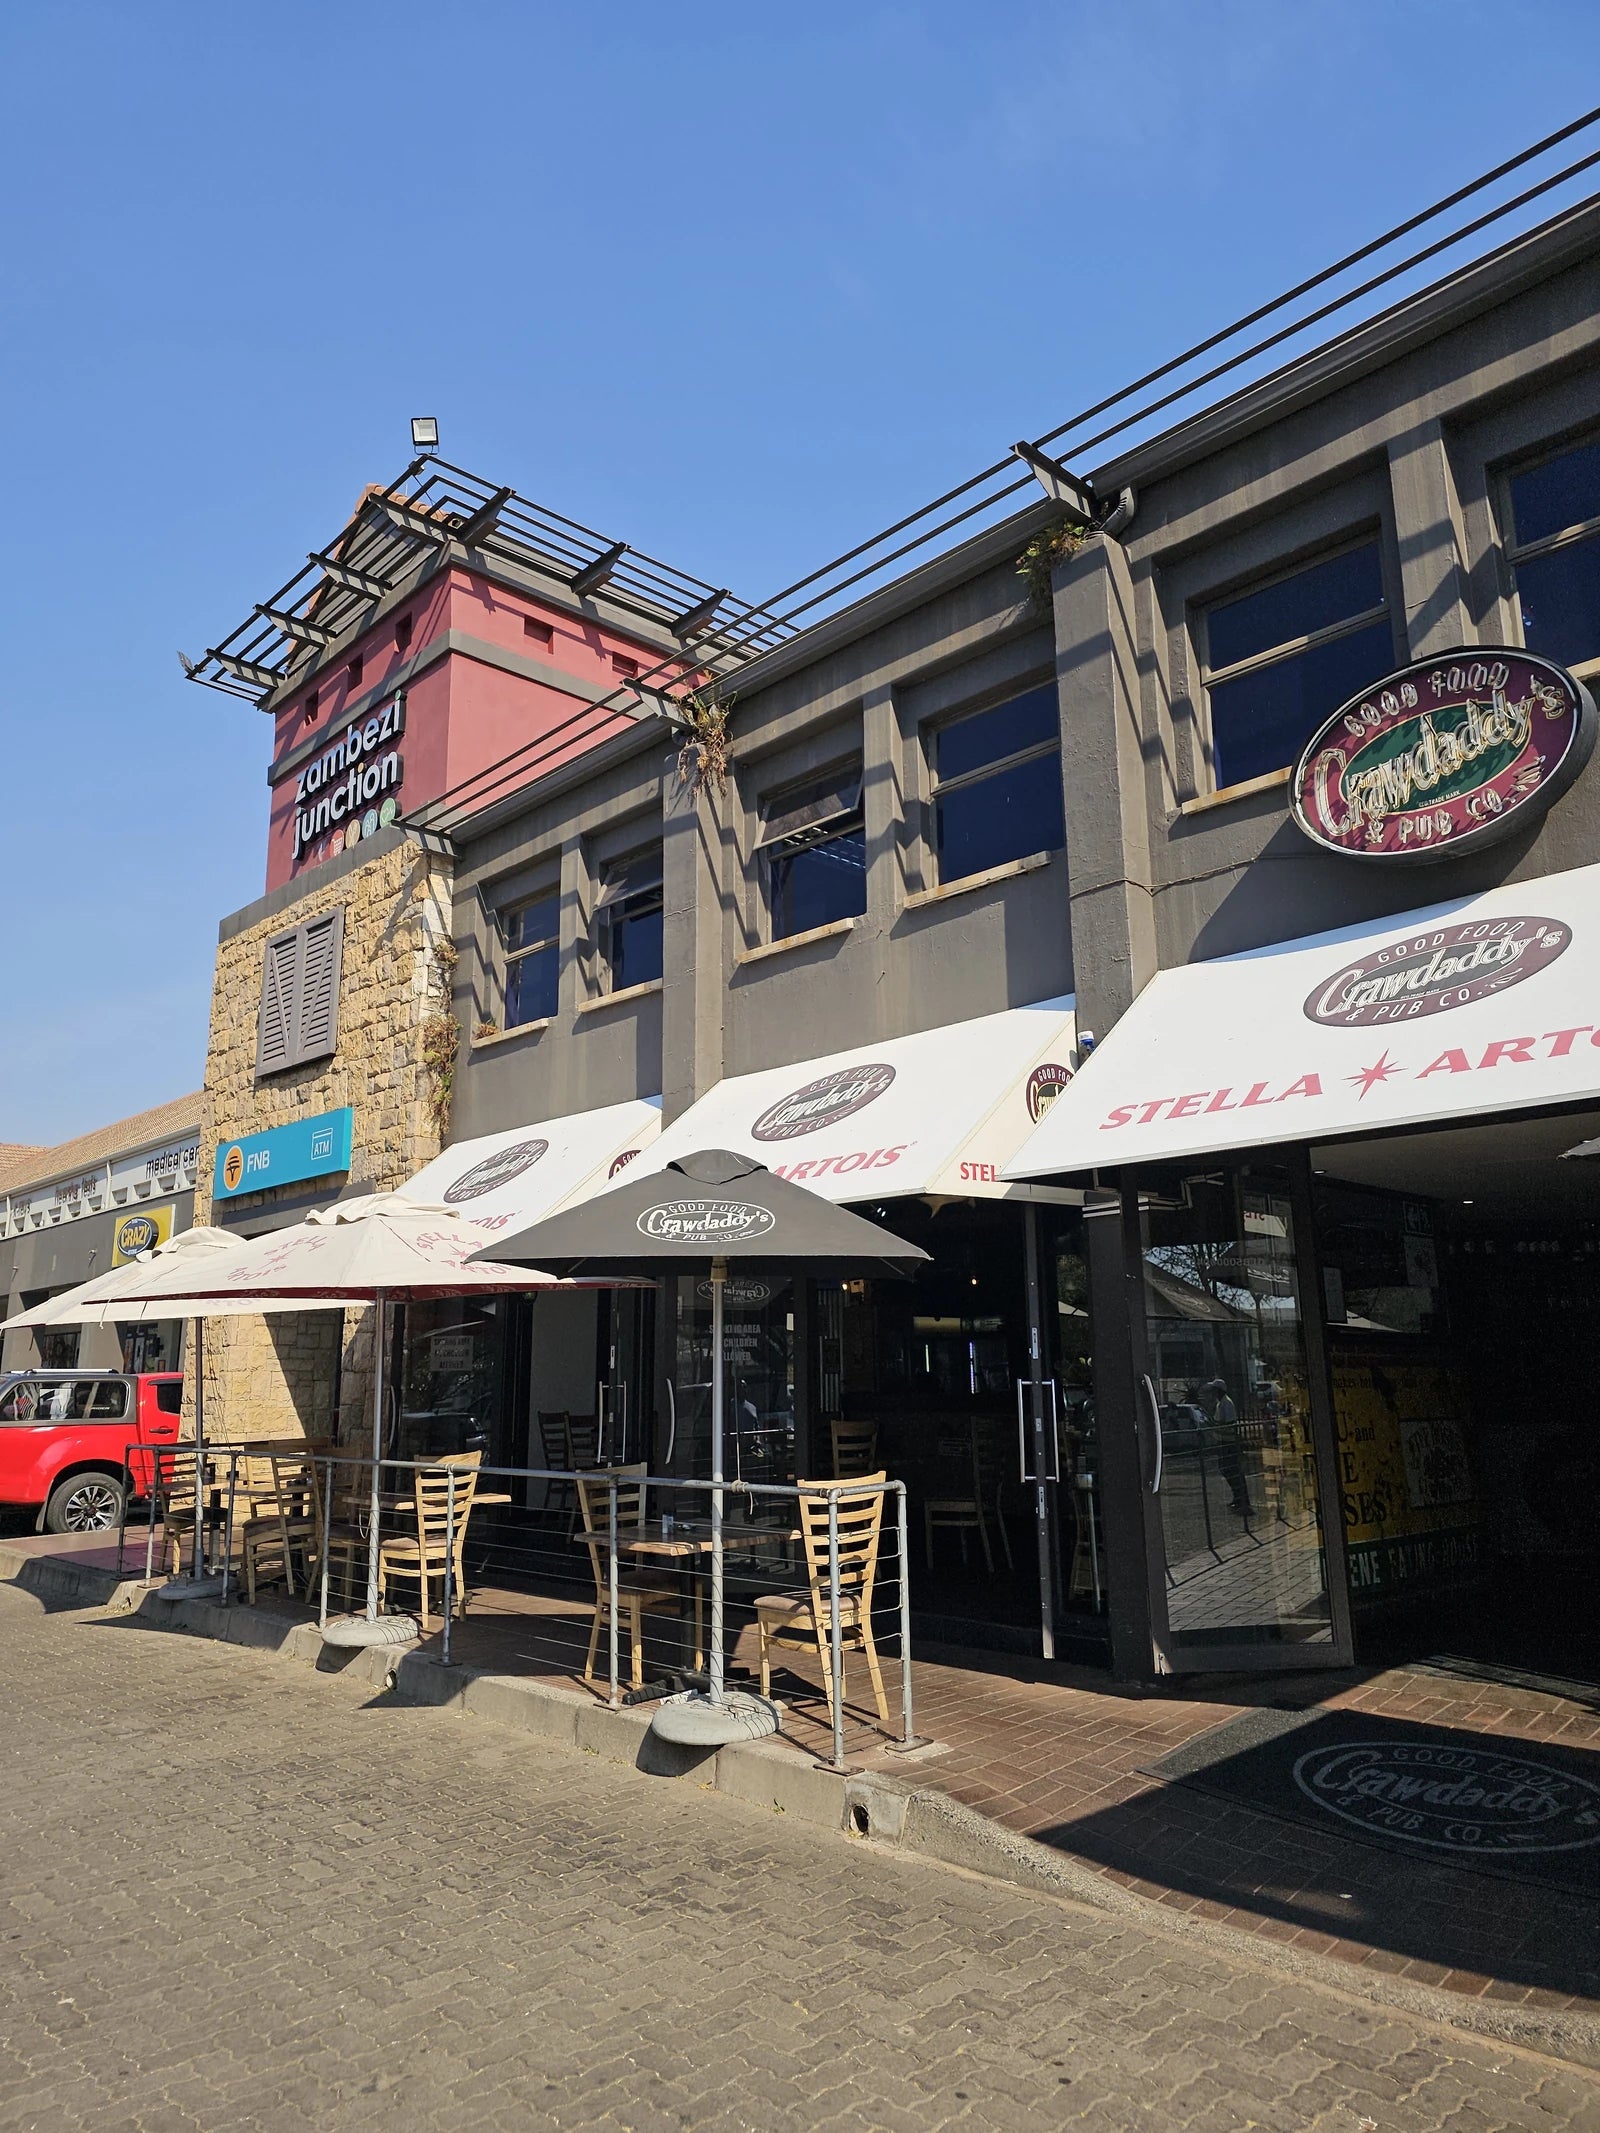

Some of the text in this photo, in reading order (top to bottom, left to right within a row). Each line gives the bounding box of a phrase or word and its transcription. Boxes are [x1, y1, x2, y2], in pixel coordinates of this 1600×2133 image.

[1344, 662, 1510, 737] GOOD FOOD
[295, 689, 401, 804] zambezi
[1314, 674, 1566, 837] Crawdaddy's
[292, 751, 398, 860] junction
[1399, 808, 1453, 844] PUB
[1377, 921, 1526, 963] GOOD FOOD
[1315, 926, 1563, 1018] Crawdaddy's
[1345, 1007, 1364, 1021] &
[1373, 1000, 1425, 1021] PUB
[1439, 988, 1483, 1008] CO.
[810, 1067, 884, 1092] GOOD FOOD
[1037, 1067, 1056, 1082] GOOD
[756, 1073, 892, 1132] Crawdaddy's
[1099, 1073, 1323, 1130] STELLA
[774, 1124, 802, 1137] PUB
[145, 1147, 183, 1178] medical
[246, 1150, 270, 1173] FNB
[313, 1140, 330, 1156] ATM
[646, 1209, 769, 1234] Crawdaddy's
[668, 1202, 747, 1214] GOOD FOOD
[121, 1223, 150, 1248] CRAZY
[683, 1233, 708, 1241] PUB
[1393, 1746, 1570, 1792] GOOD FOOD
[1367, 1806, 1425, 1830] PUB
